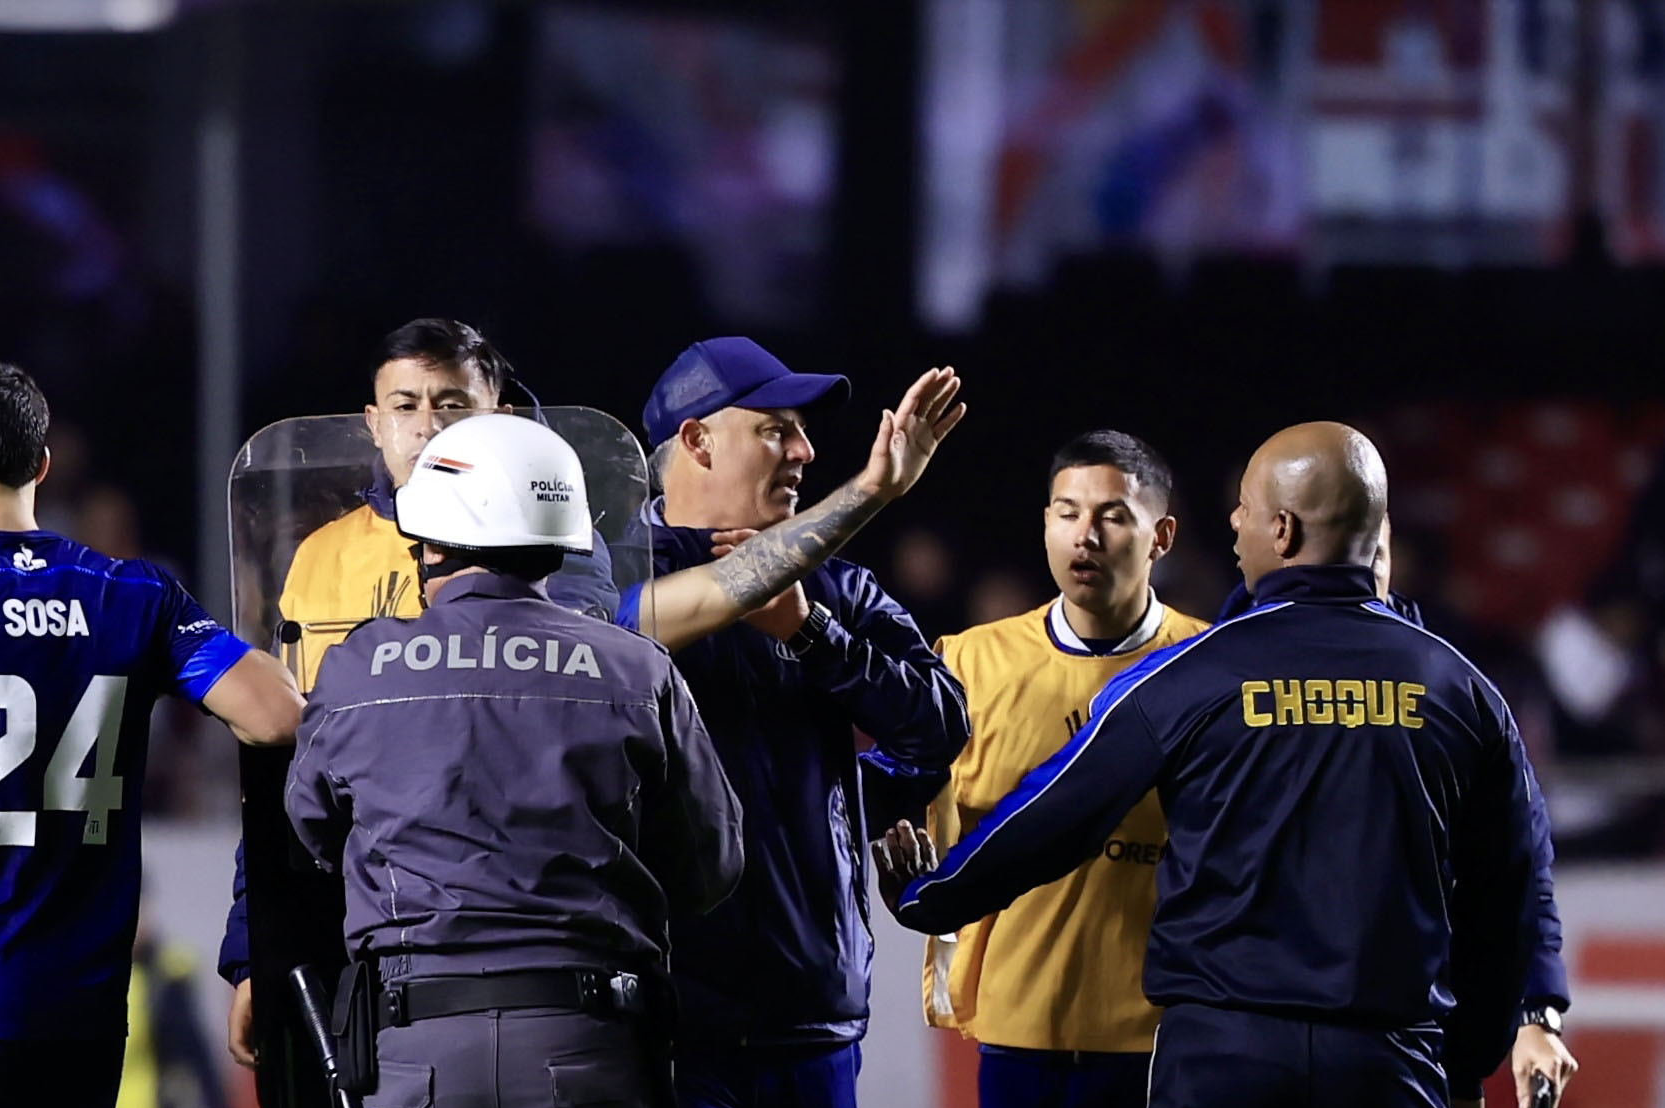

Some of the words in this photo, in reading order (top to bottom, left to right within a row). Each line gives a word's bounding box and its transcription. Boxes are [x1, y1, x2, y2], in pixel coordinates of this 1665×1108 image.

[536, 493, 570, 502] MILITAR
[2, 598, 90, 637] SOSA
[370, 625, 602, 679] POLÍCIA
[1241, 679, 1426, 729] CHOQUE
